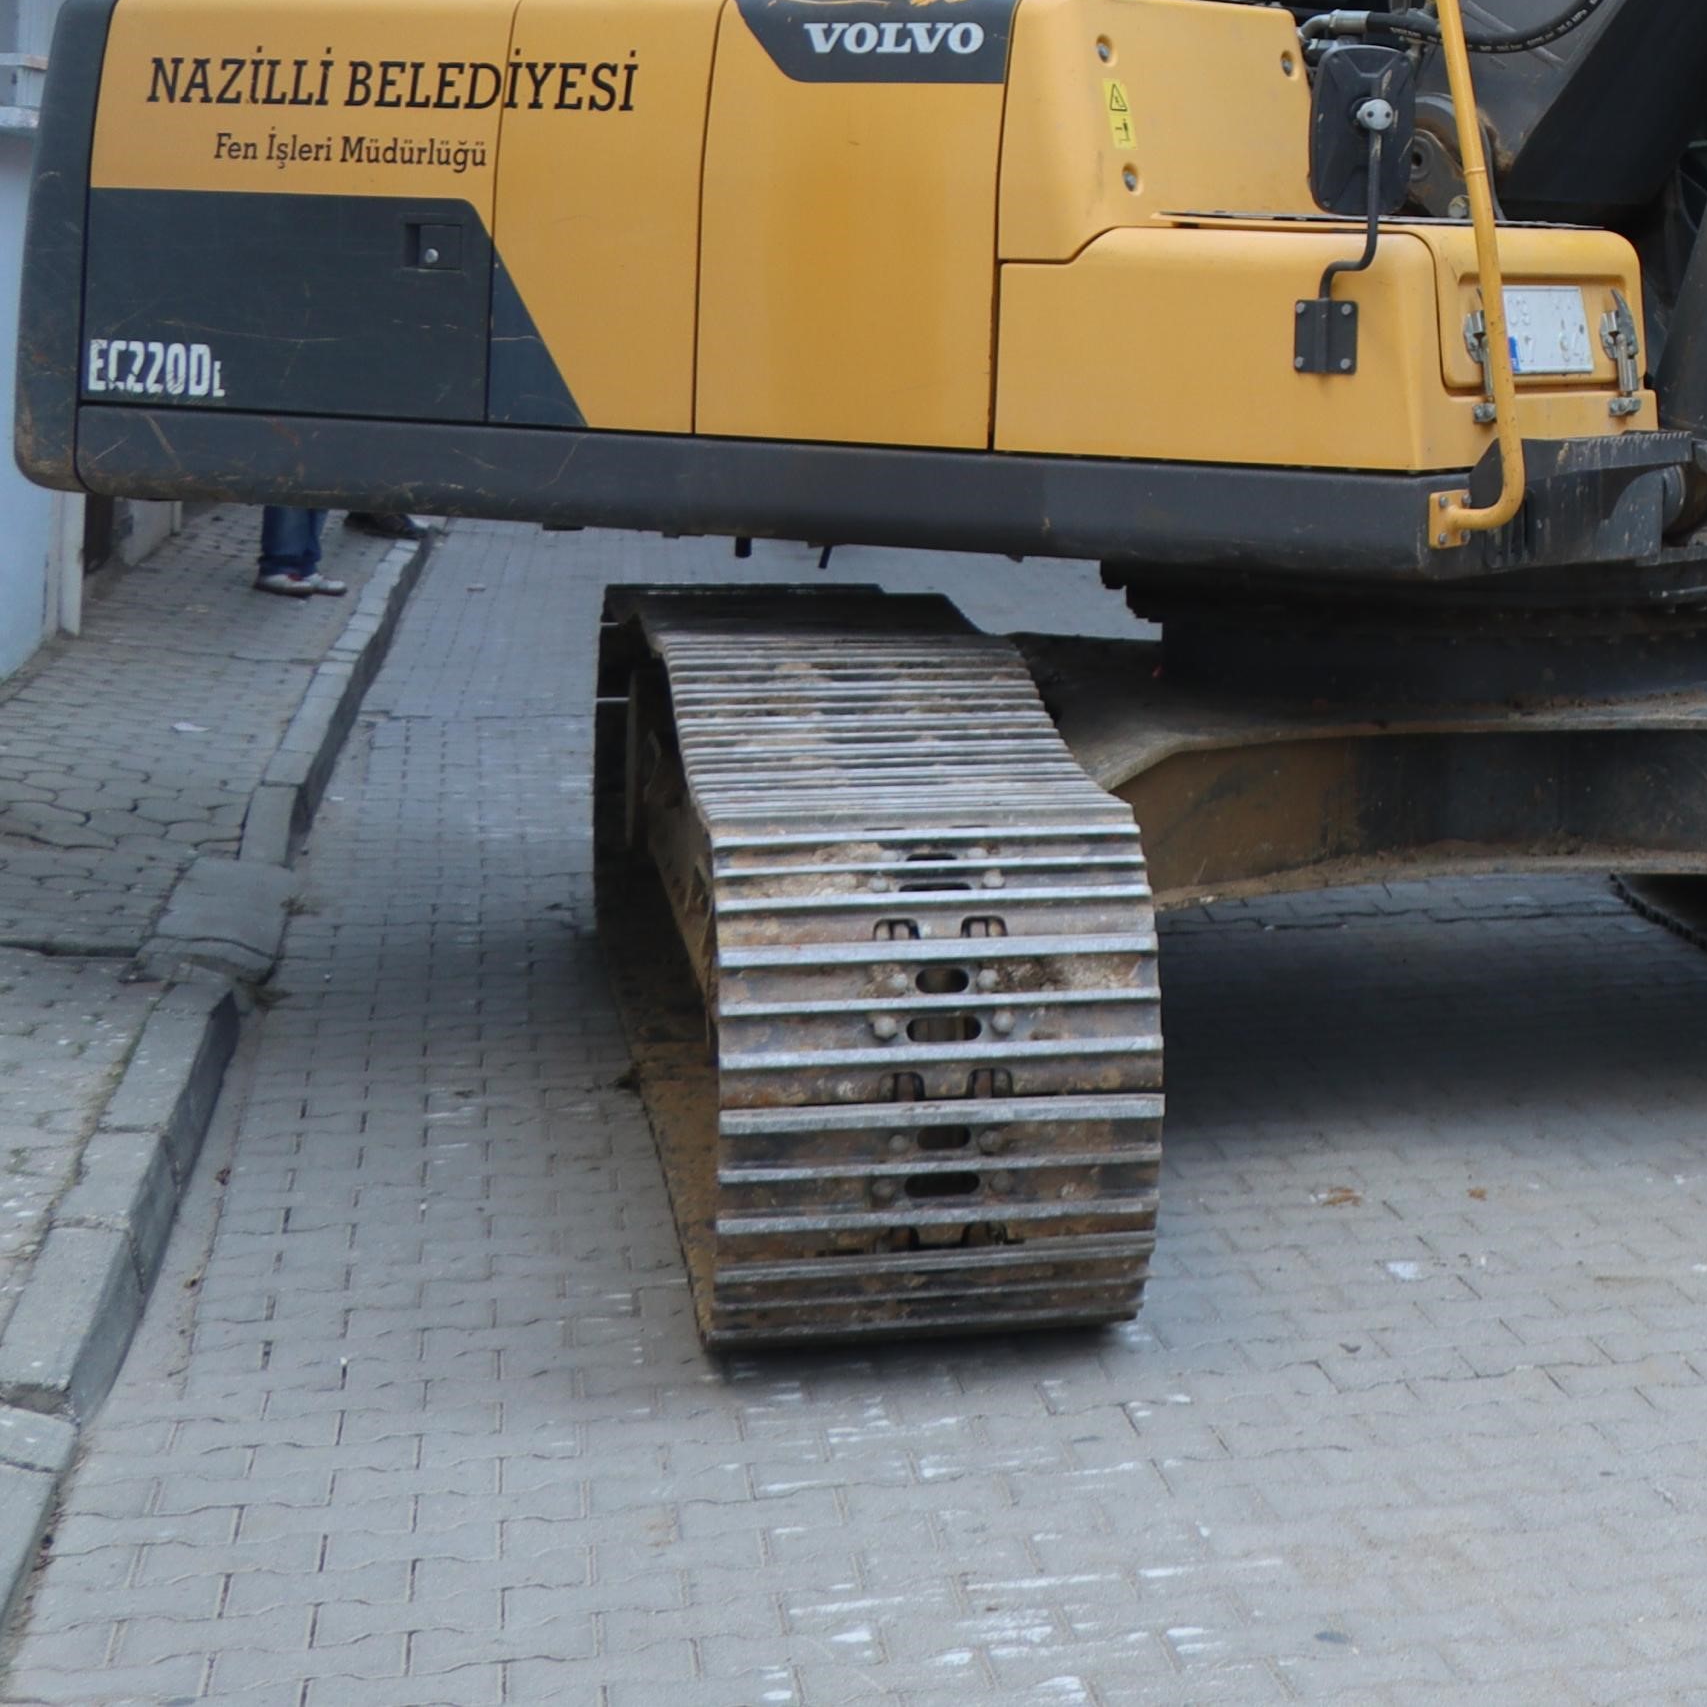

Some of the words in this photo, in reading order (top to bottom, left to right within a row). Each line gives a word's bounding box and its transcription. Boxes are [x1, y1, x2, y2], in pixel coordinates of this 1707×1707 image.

[803, 22, 985, 55] VOLVO
[147, 46, 334, 106] NAZİLLİ
[344, 48, 638, 112] BELEDİYESİ
[213, 132, 258, 161] Fen
[266, 125, 332, 170] İşleri
[340, 135, 487, 174] Müdürlüğü
